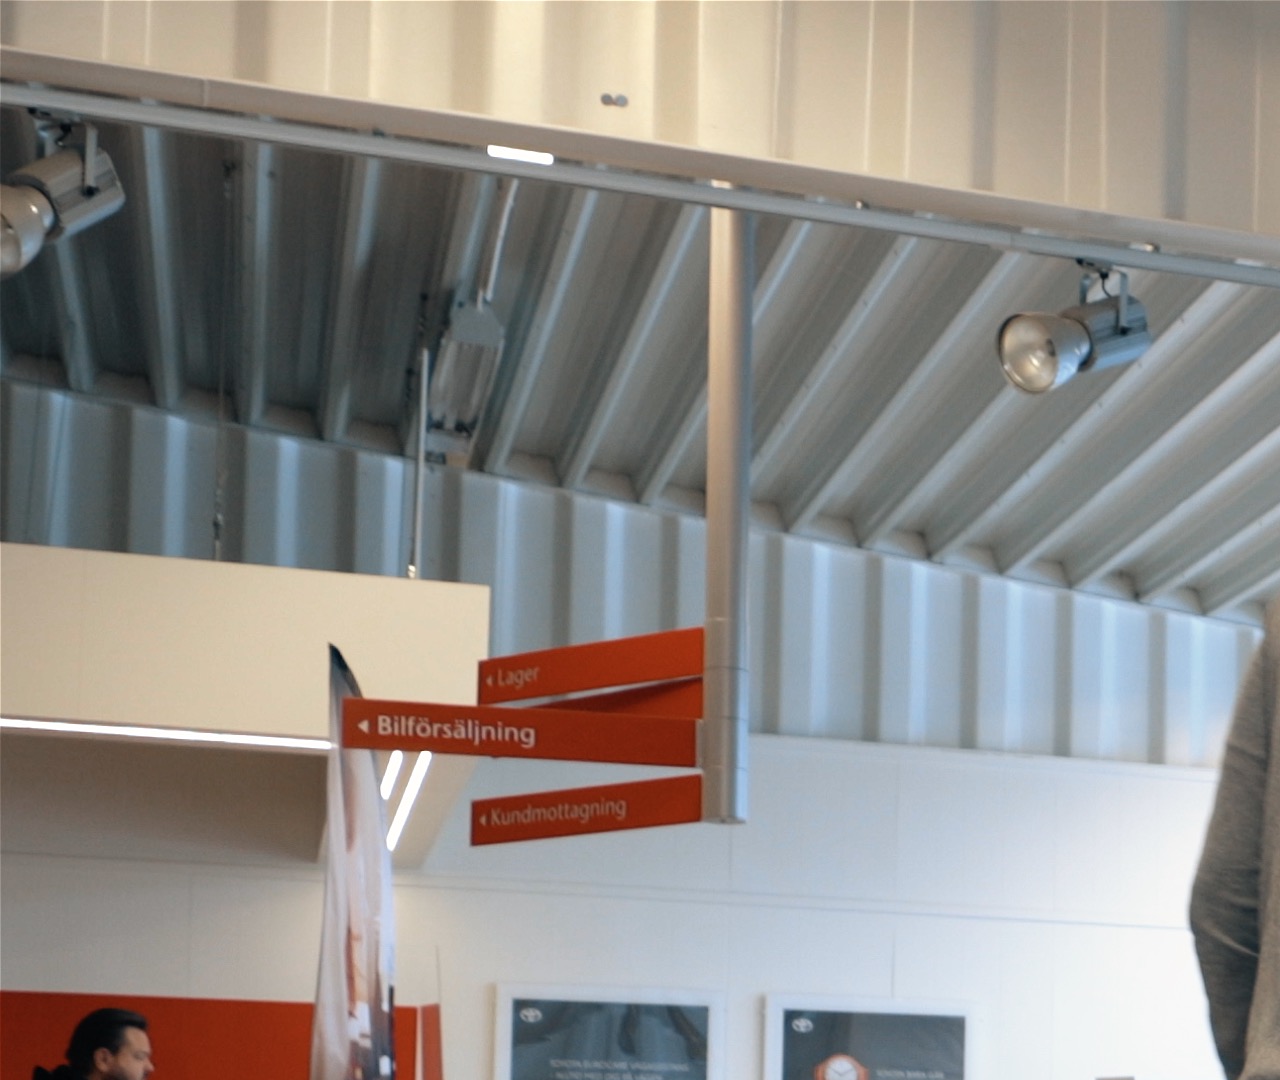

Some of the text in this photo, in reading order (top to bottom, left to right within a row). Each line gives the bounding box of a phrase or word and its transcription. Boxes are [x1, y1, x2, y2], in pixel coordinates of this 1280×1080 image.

[498, 665, 539, 688] Lager
[377, 715, 536, 748] Bilförsäljning
[490, 798, 627, 826] Kundmottagning
